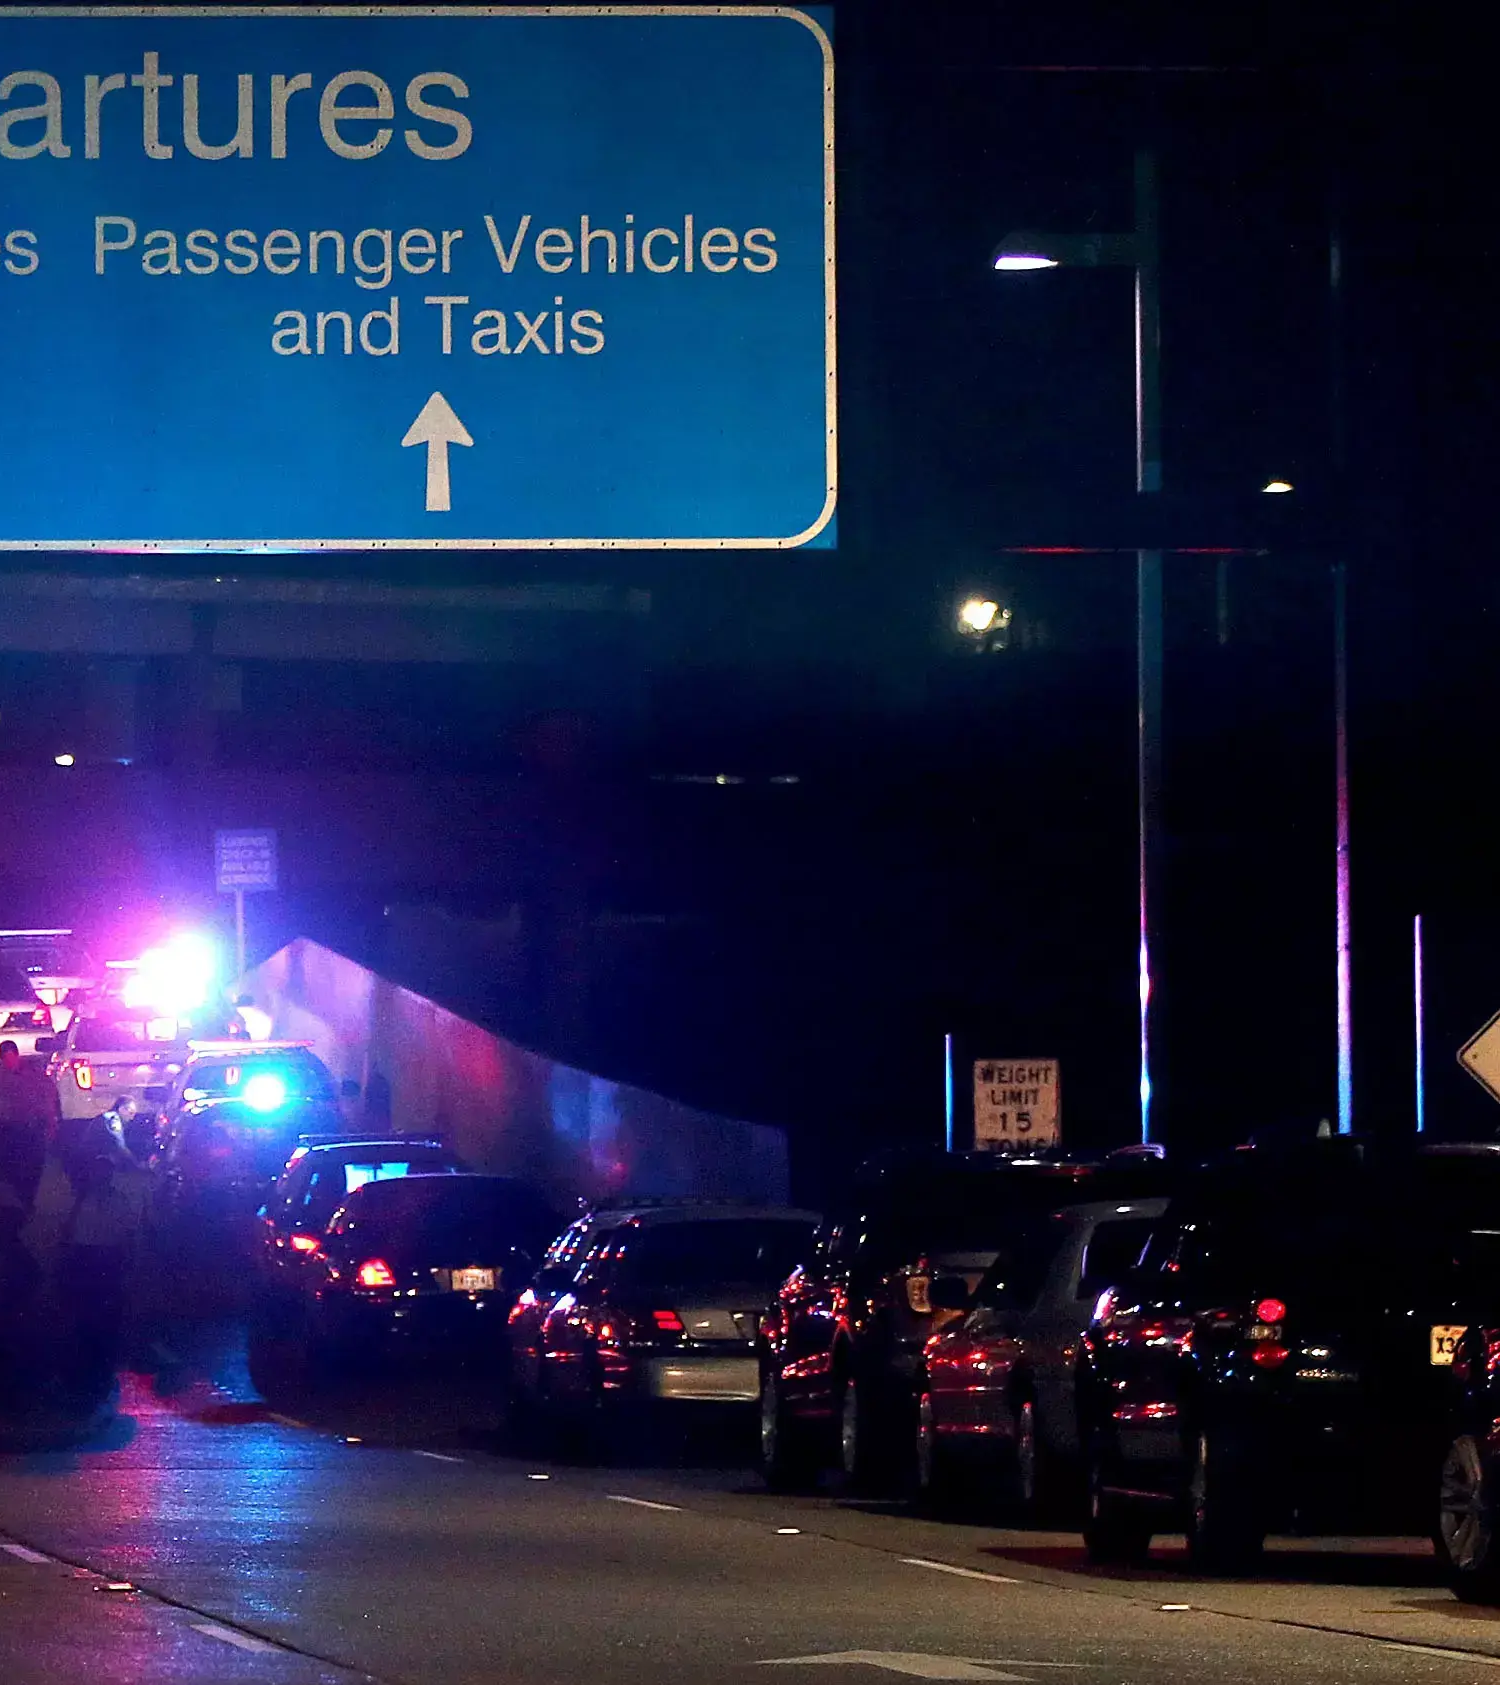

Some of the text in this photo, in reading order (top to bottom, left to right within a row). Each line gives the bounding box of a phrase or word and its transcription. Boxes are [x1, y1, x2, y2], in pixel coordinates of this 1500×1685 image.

[94, 215, 778, 290] Passenger Vehicles
[271, 296, 606, 357] and Taxis
[980, 1064, 1052, 1084] WEIGHT
[990, 1088, 1039, 1106] LIMIT
[999, 1111, 1032, 1133] 15
